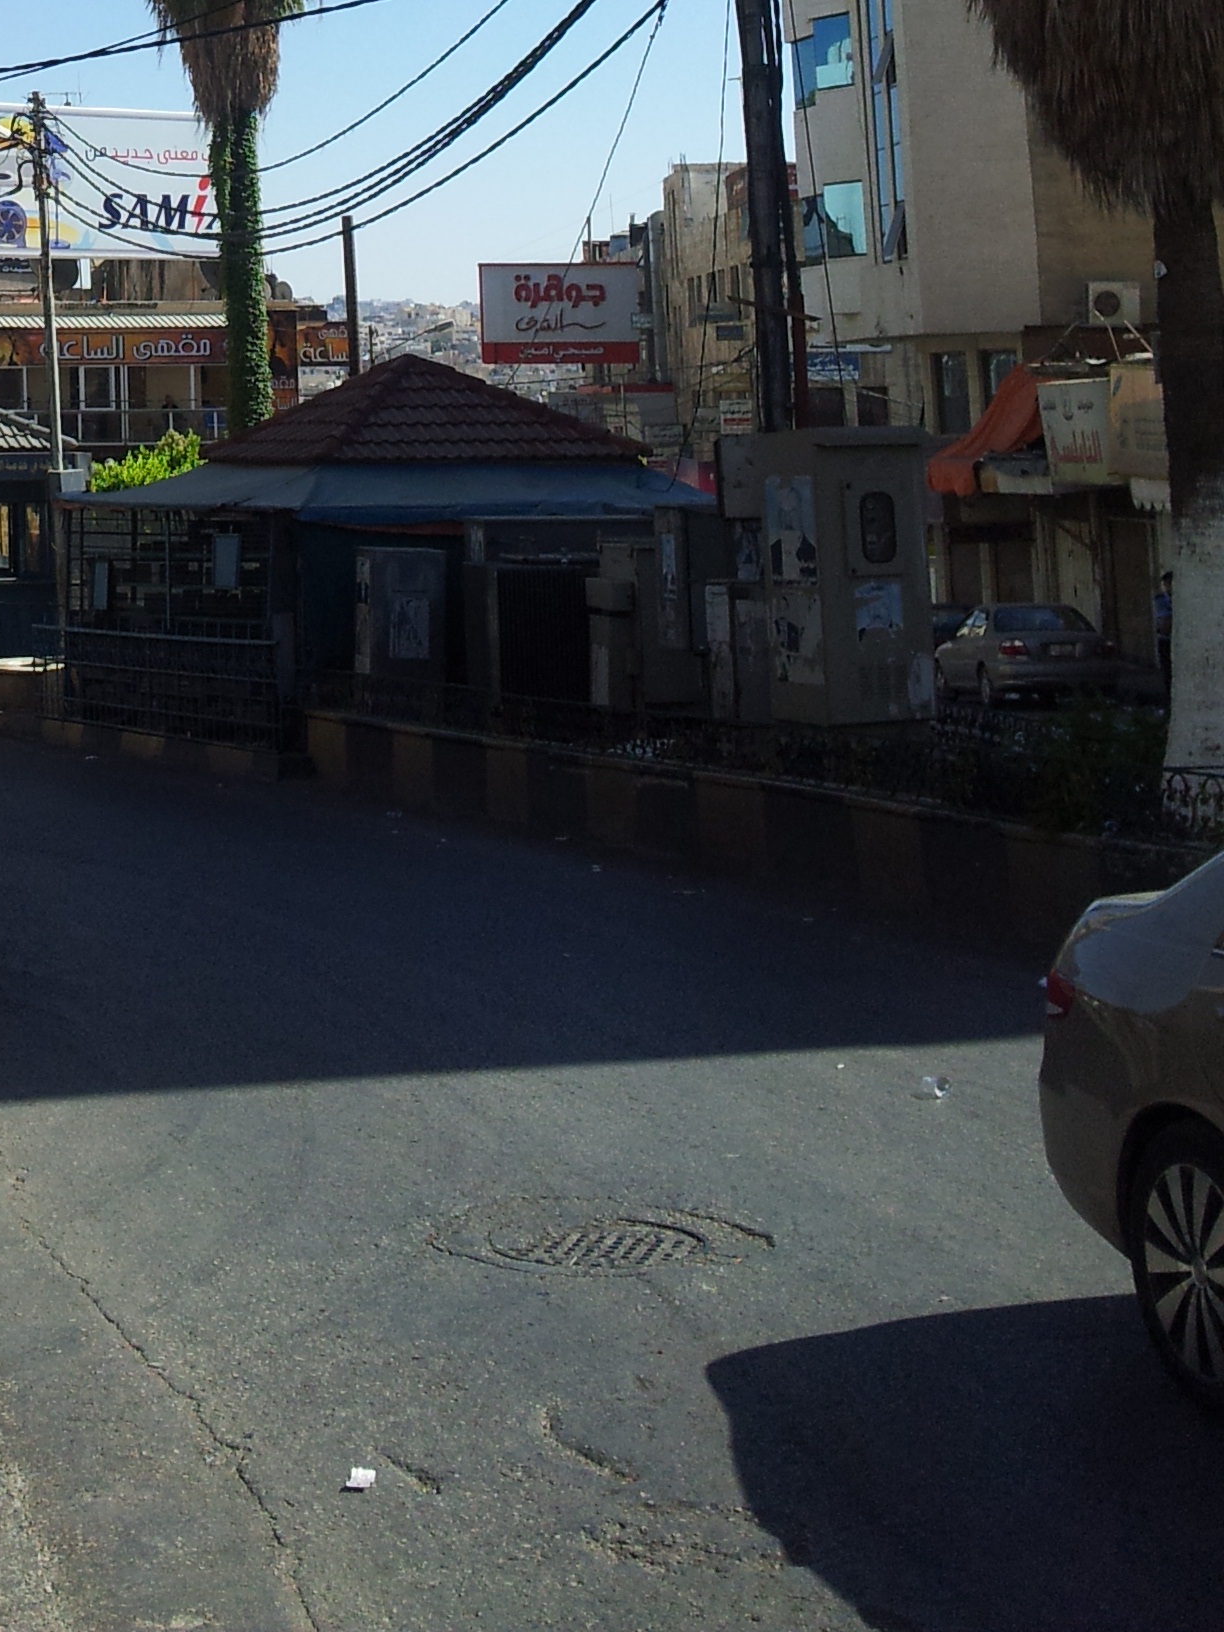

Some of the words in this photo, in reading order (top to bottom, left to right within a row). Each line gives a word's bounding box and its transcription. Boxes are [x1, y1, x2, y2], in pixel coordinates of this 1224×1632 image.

[157, 146, 198, 165] معنى
[514, 273, 606, 309] جوهرة
[318, 326, 348, 340] قهى
[132, 333, 212, 360] مقهى
